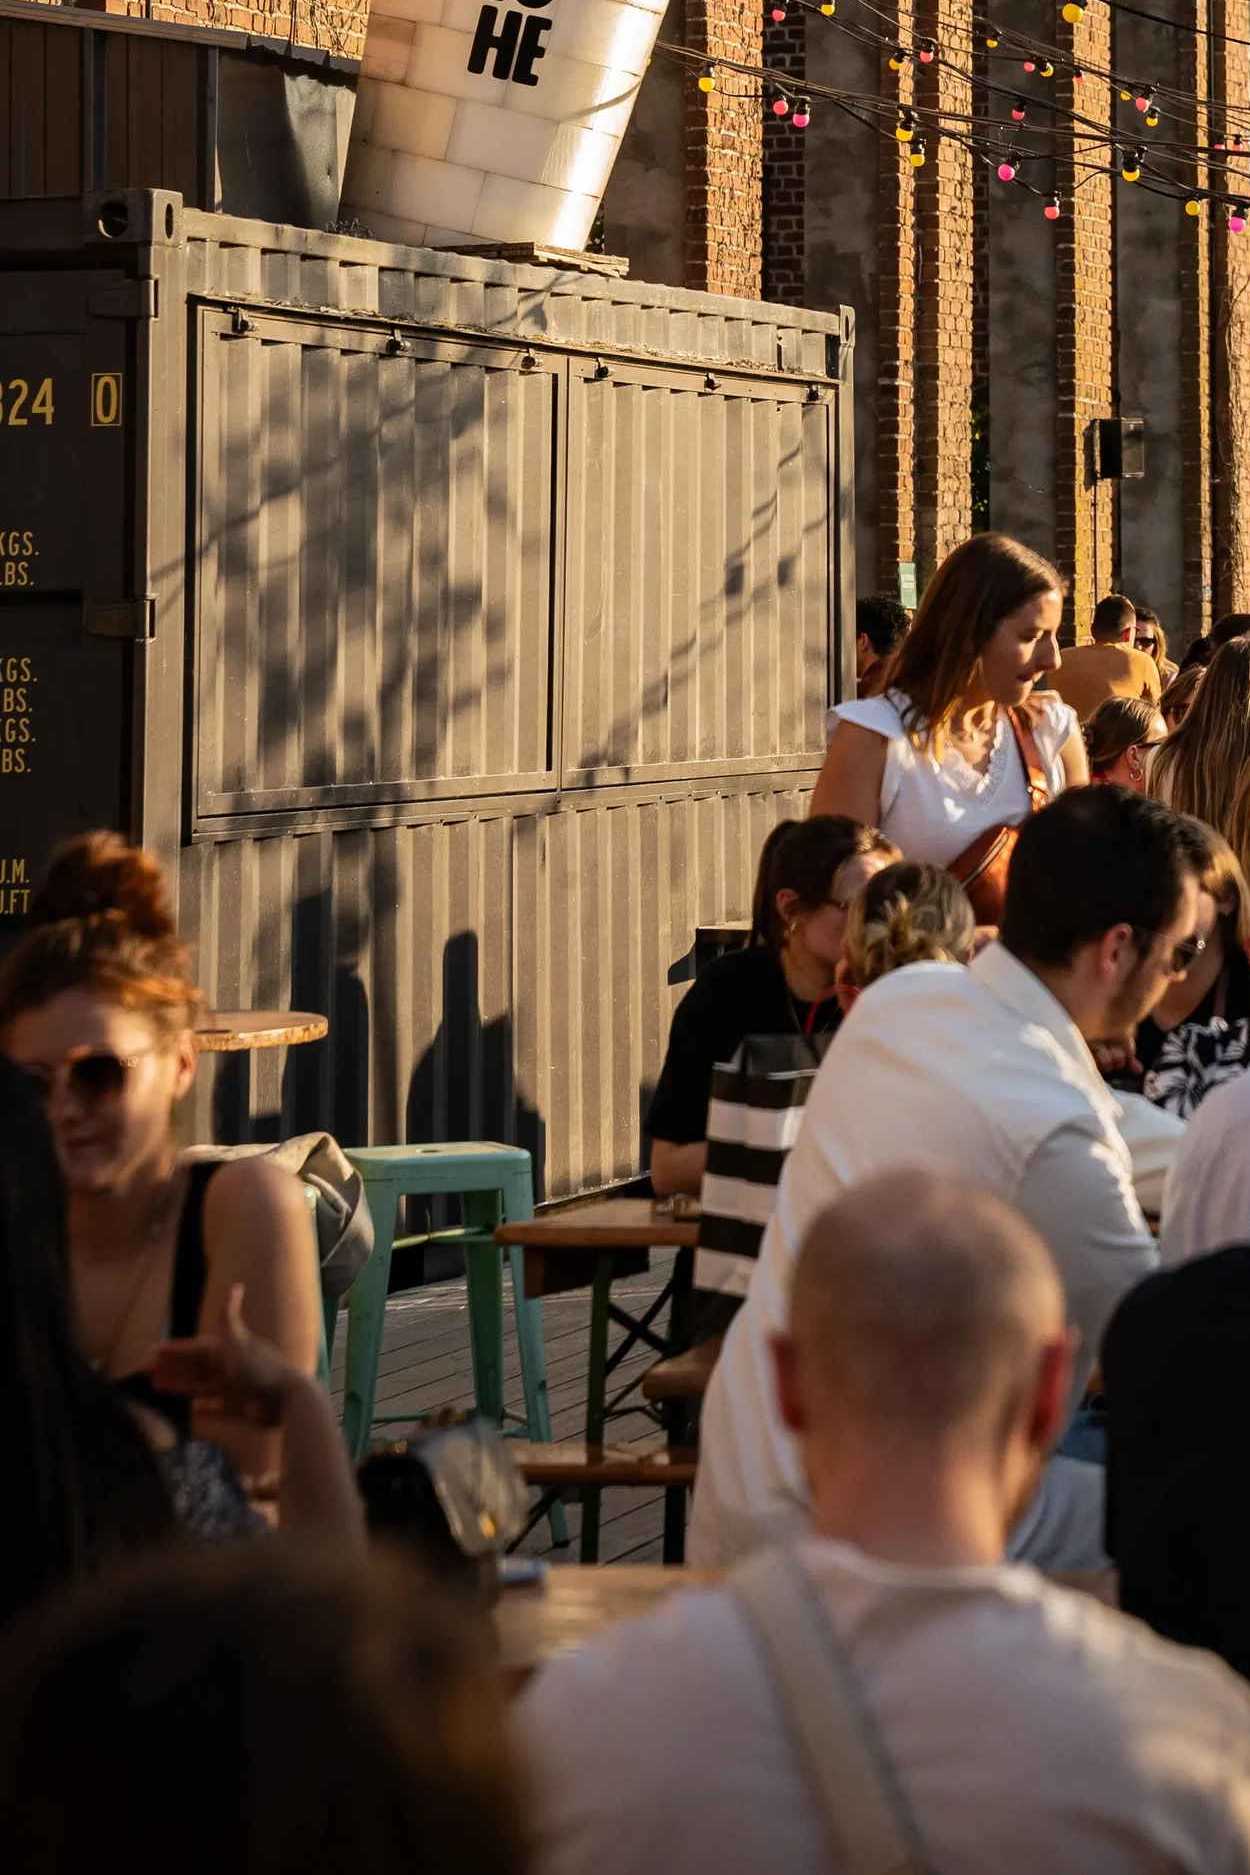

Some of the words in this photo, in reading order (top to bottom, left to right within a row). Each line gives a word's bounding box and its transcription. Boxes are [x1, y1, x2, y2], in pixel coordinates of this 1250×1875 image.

[467, 4, 553, 87] HE
[0, 378, 54, 425] 24
[0, 561, 34, 586] BS.
[0, 717, 36, 743] GS.
